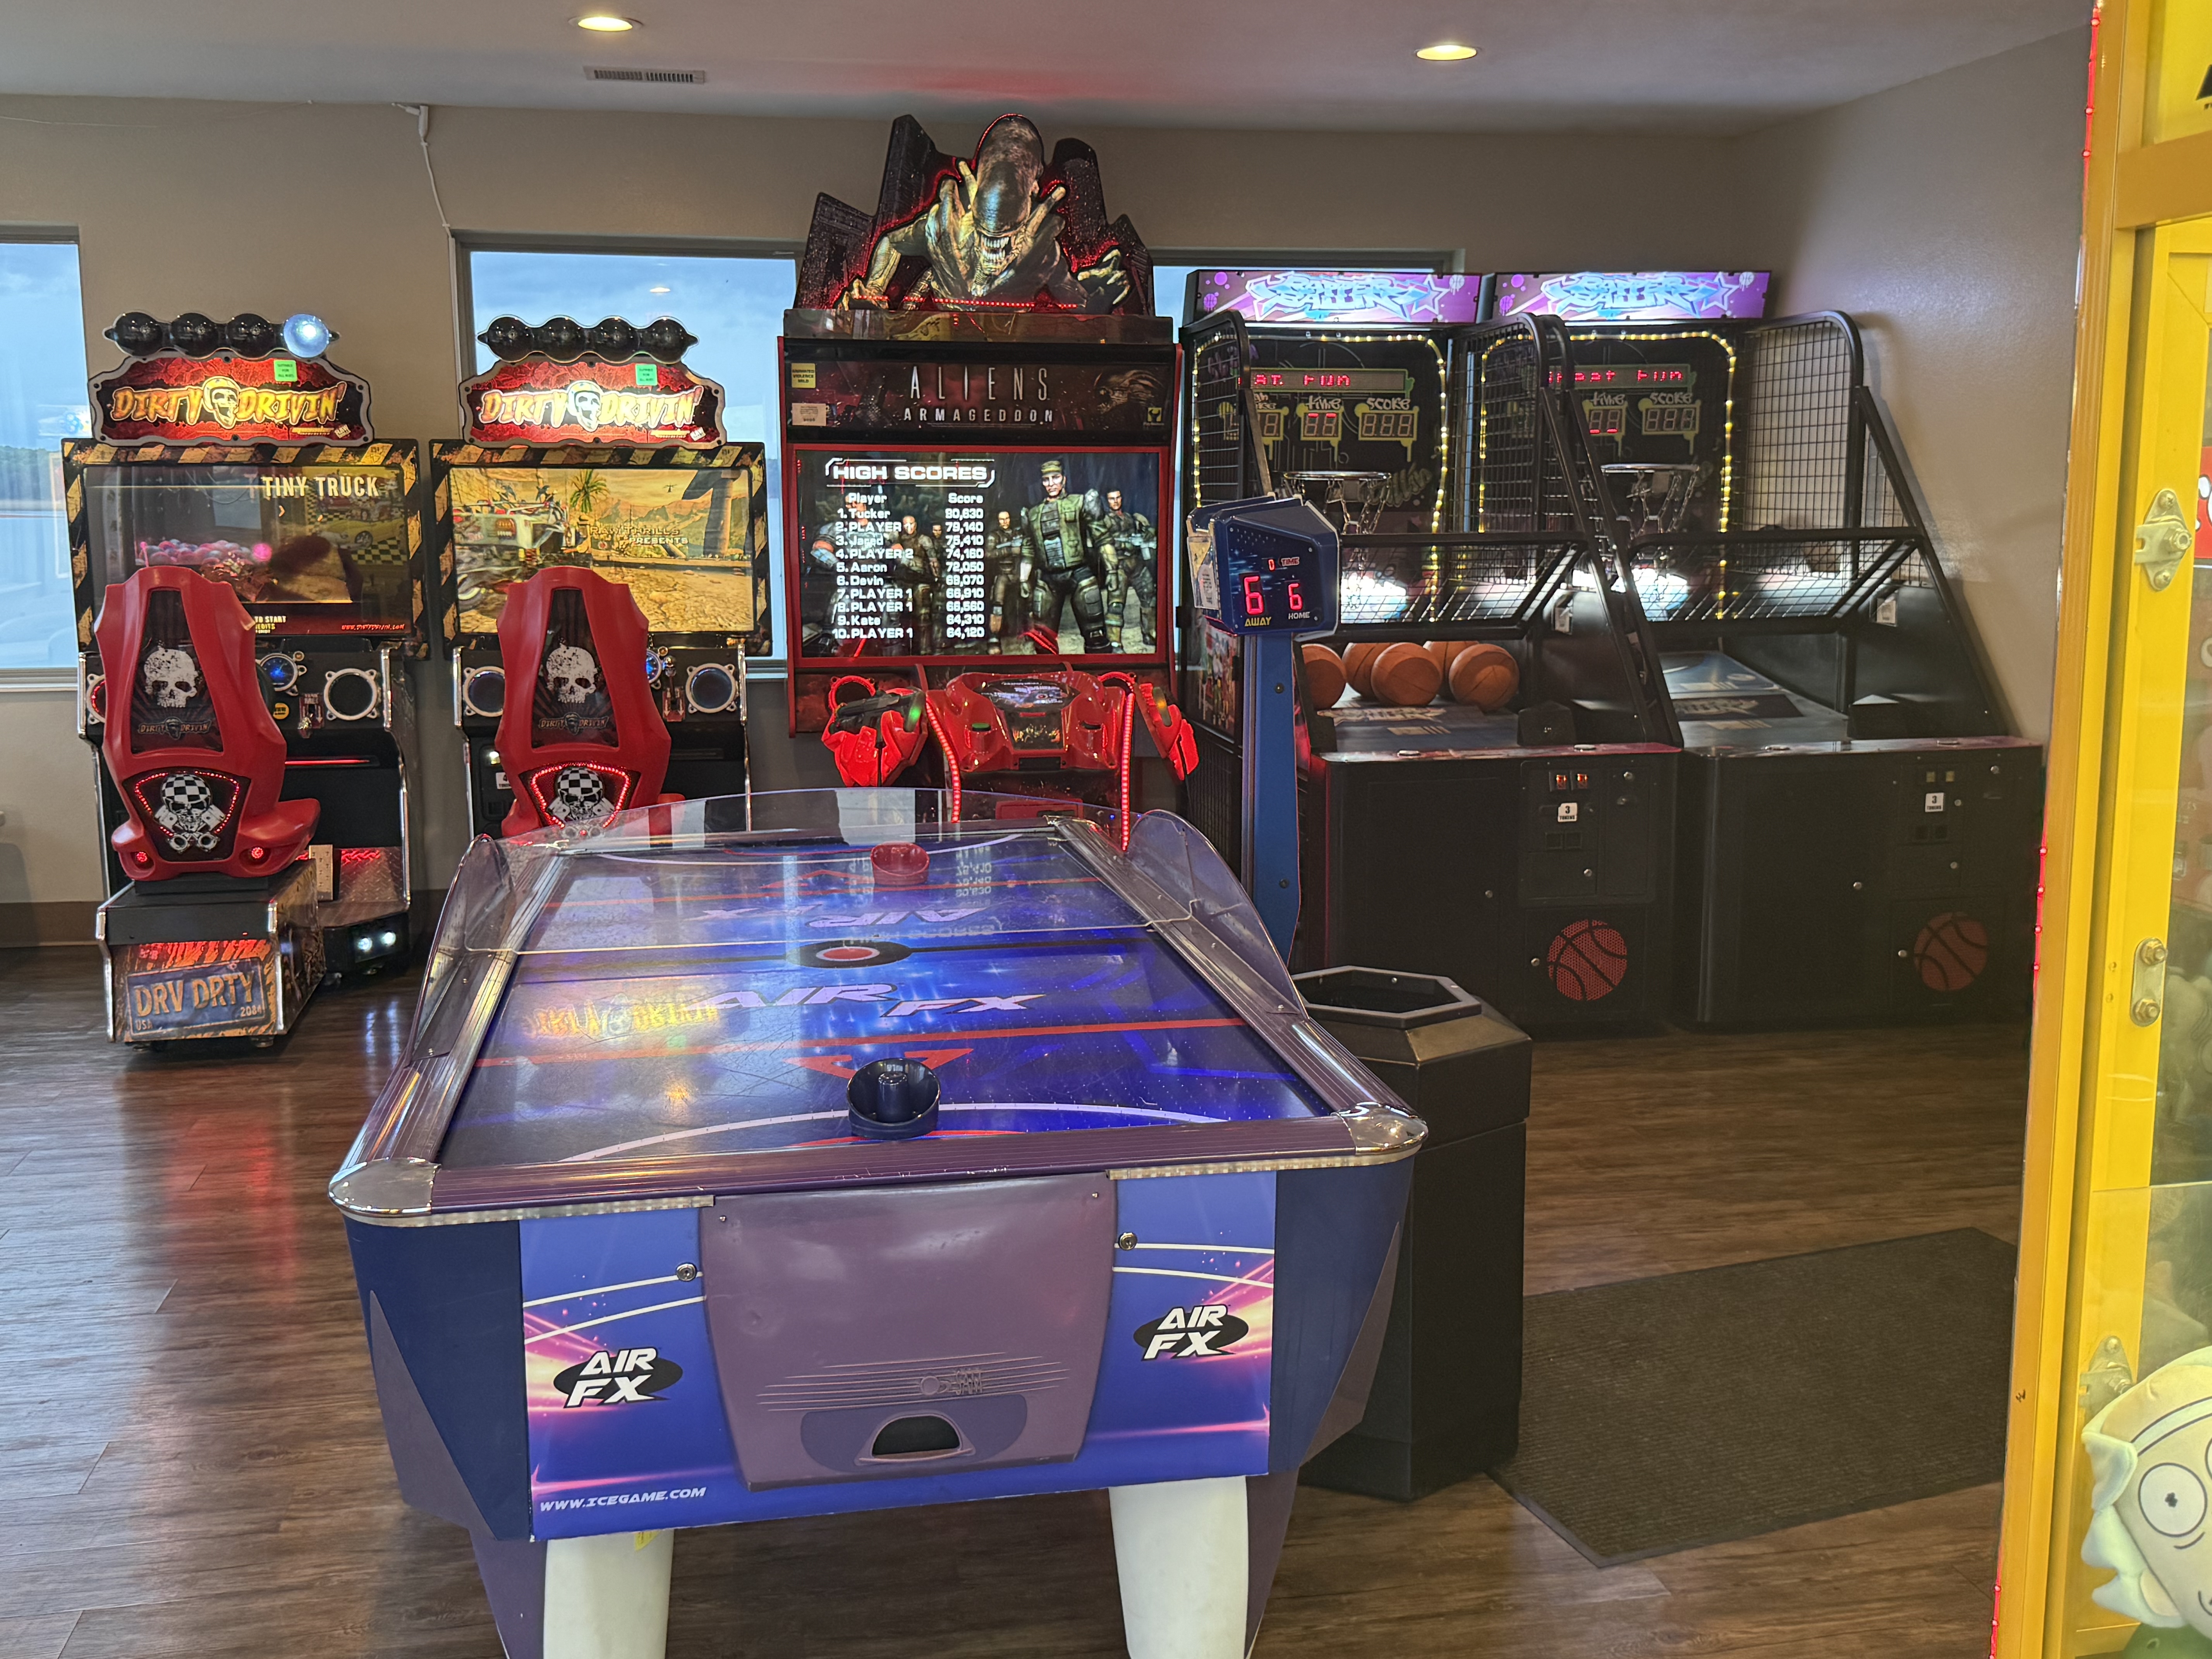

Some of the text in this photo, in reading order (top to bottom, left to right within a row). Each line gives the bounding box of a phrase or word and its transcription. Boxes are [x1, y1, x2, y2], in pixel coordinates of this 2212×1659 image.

[910, 366, 1048, 401] ALIENS
[1305, 396, 1341, 410] time
[1590, 392, 1625, 405] time
[113, 386, 204, 425] DIRTY
[479, 390, 568, 428] DIRTY
[903, 408, 1053, 422] ARMAGEDDON
[833, 466, 987, 480] HIGH SCORES
[262, 476, 379, 497] TINY TRUCK
[848, 493, 983, 505] Player Score
[624, 526, 680, 535] THRILLS
[904, 522, 912, 532] 1
[945, 521, 984, 534] 79,140
[945, 535, 984, 548] 75,410
[905, 548, 914, 559] 2
[946, 548, 984, 561] 74,160
[946, 561, 984, 574] 72,050
[1281, 557, 1300, 567] TIME
[906, 589, 912, 599] 1
[946, 587, 984, 600] 66,910
[1243, 575, 1264, 615] 6
[1288, 583, 1303, 611] 6
[906, 602, 913, 612] 1
[946, 601, 984, 613] 66,560
[946, 614, 984, 627] 64,310
[1244, 617, 1271, 627] AWAY
[907, 628, 913, 639] 1
[947, 627, 985, 639] 64,120
[140, 724, 165, 733] DIRTY
[1932, 795, 1937, 804] 3
[1565, 805, 1570, 814] 3
[134, 970, 255, 1017] DRV DRTY
[683, 983, 1046, 1018] AIR FX
[135, 1019, 153, 1031] USA
[1157, 1304, 1228, 1330] AIR
[1143, 1330, 1226, 1360] FX
[579, 1347, 658, 1376] AIR
[565, 1374, 657, 1408] FX
[540, 1486, 707, 1512] WWW.ICEGAME.COM
